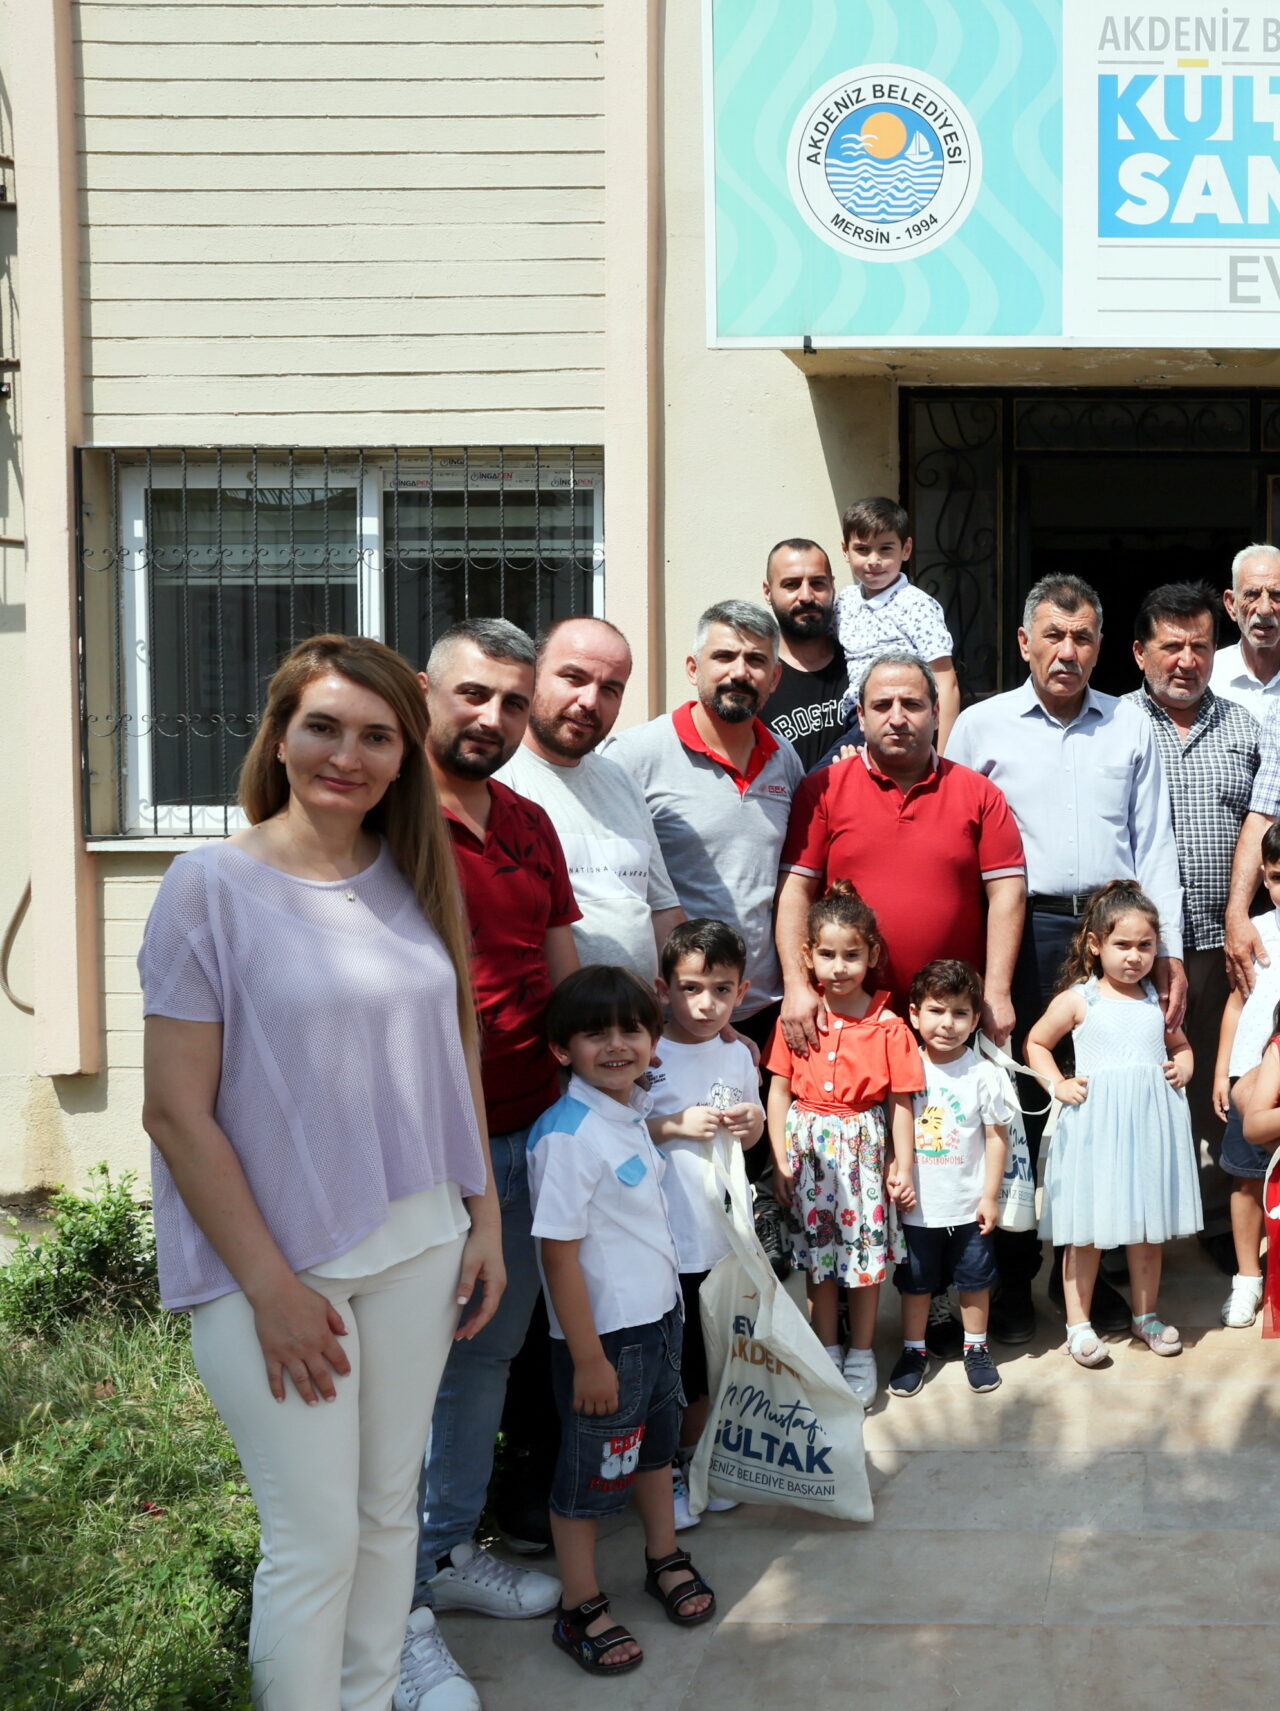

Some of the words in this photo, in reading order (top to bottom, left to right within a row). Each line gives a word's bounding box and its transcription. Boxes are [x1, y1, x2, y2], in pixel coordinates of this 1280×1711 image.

[1098, 7, 1251, 53] AKDENİZ
[806, 87, 866, 165] AKDENİZ
[872, 83, 967, 165] BELEDİYESİ
[830, 213, 890, 244] MERSİN
[904, 213, 939, 239] 1994
[737, 1467, 786, 1490] BELEDİYE
[787, 1480, 836, 1497] BAŞKANI
